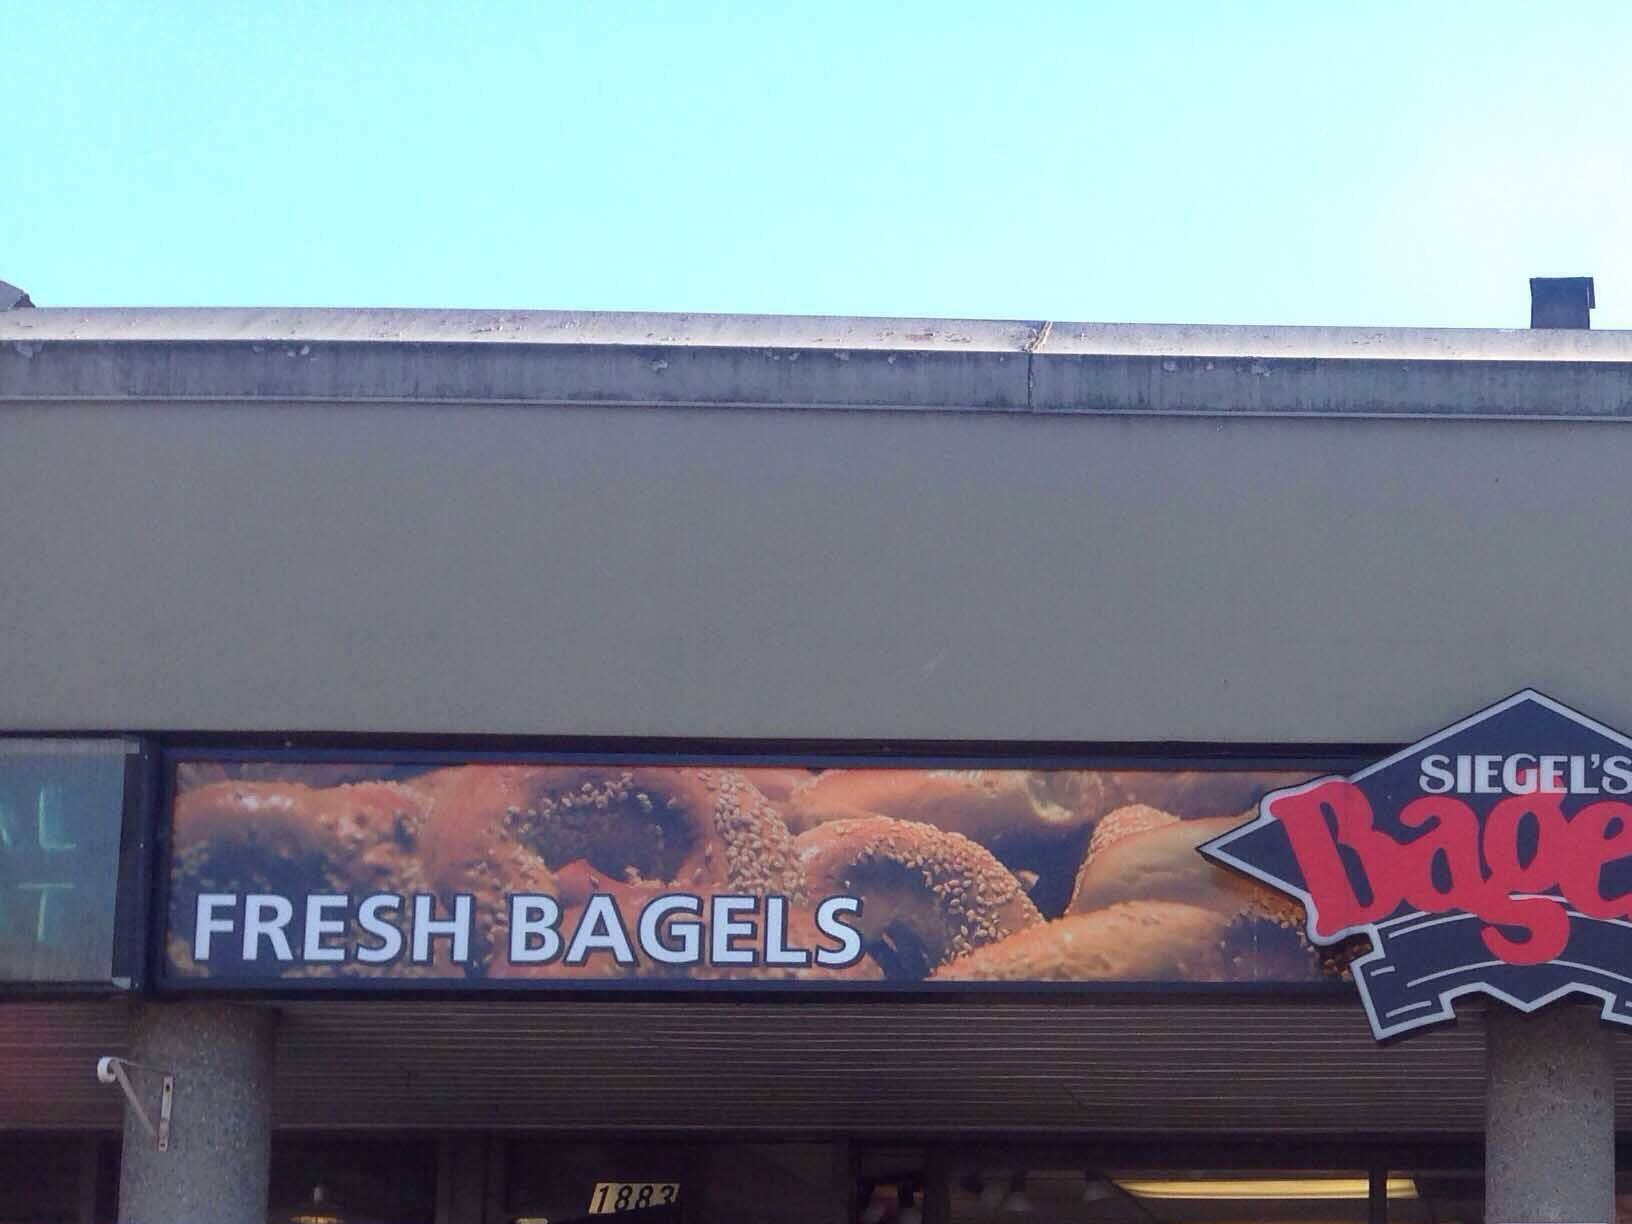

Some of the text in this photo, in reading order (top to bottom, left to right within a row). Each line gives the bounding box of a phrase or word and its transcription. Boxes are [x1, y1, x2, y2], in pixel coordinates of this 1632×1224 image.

[193, 892, 863, 965] FRESH BAGELS
[596, 1184, 676, 1213] 1883
